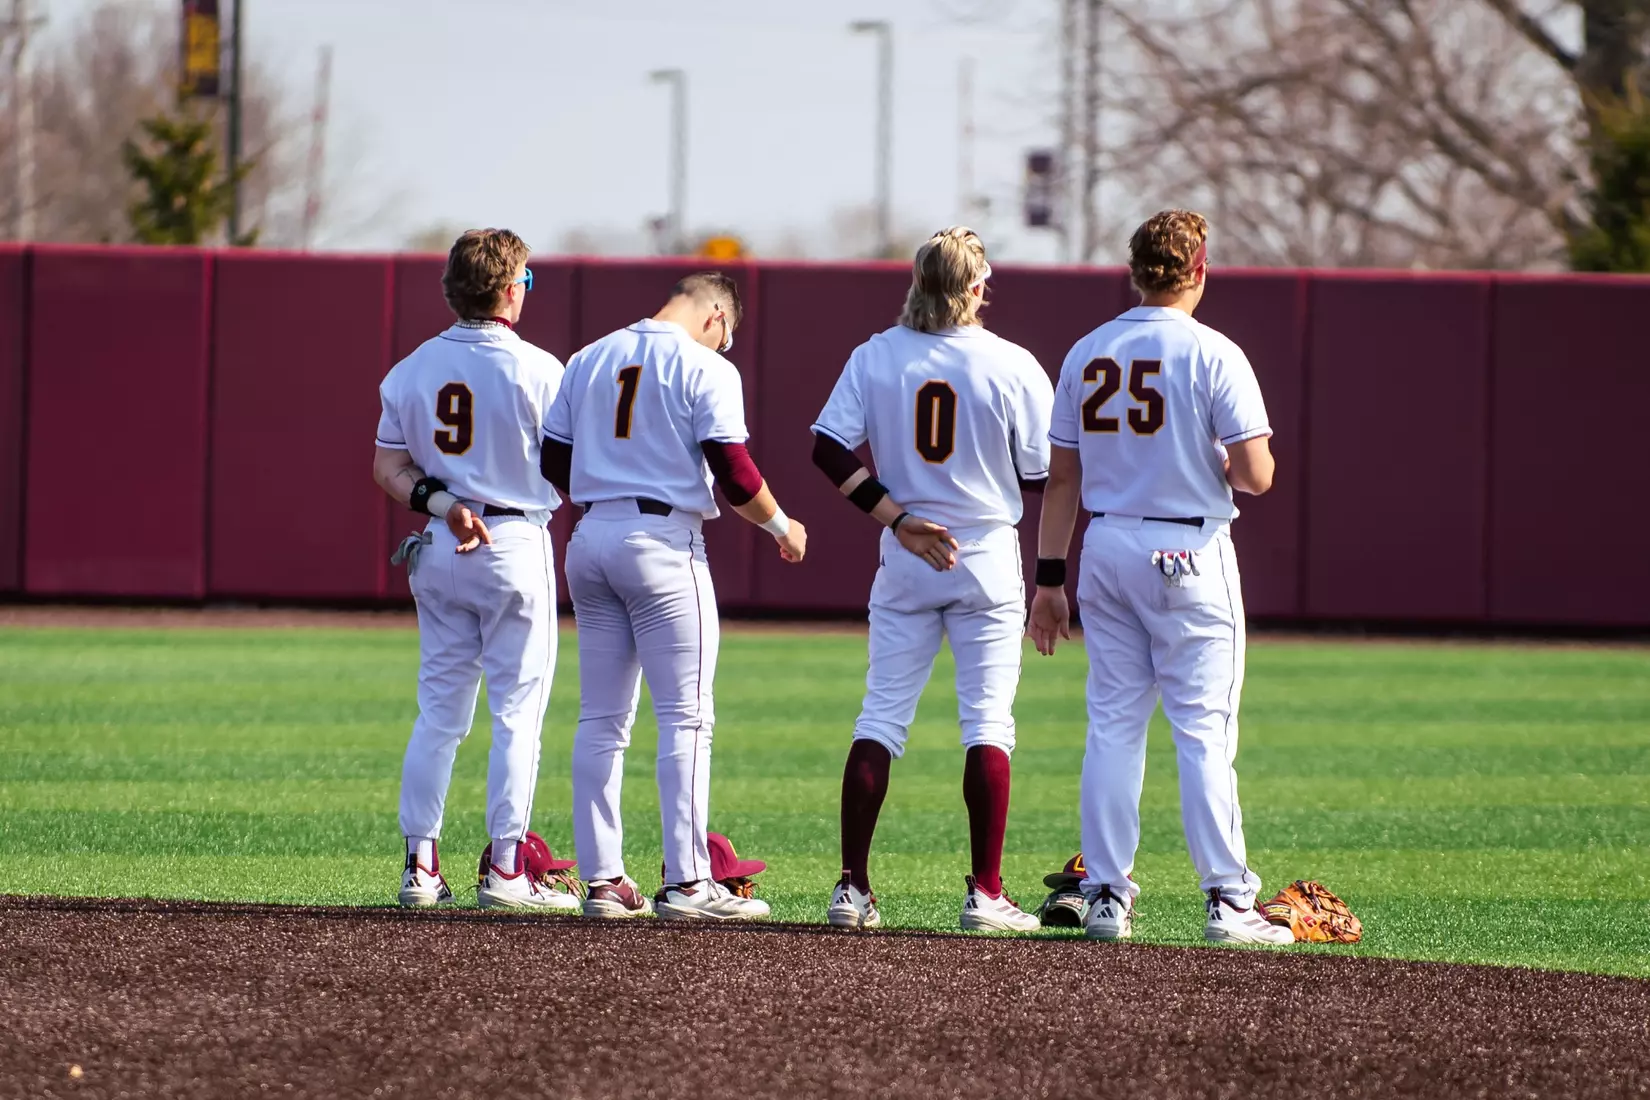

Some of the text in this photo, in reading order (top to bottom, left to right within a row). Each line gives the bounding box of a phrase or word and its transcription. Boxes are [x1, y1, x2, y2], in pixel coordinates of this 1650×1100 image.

[434, 381, 474, 456] 9
[614, 364, 643, 439] 1
[914, 378, 958, 464] 0
[1082, 356, 1165, 436] 25
